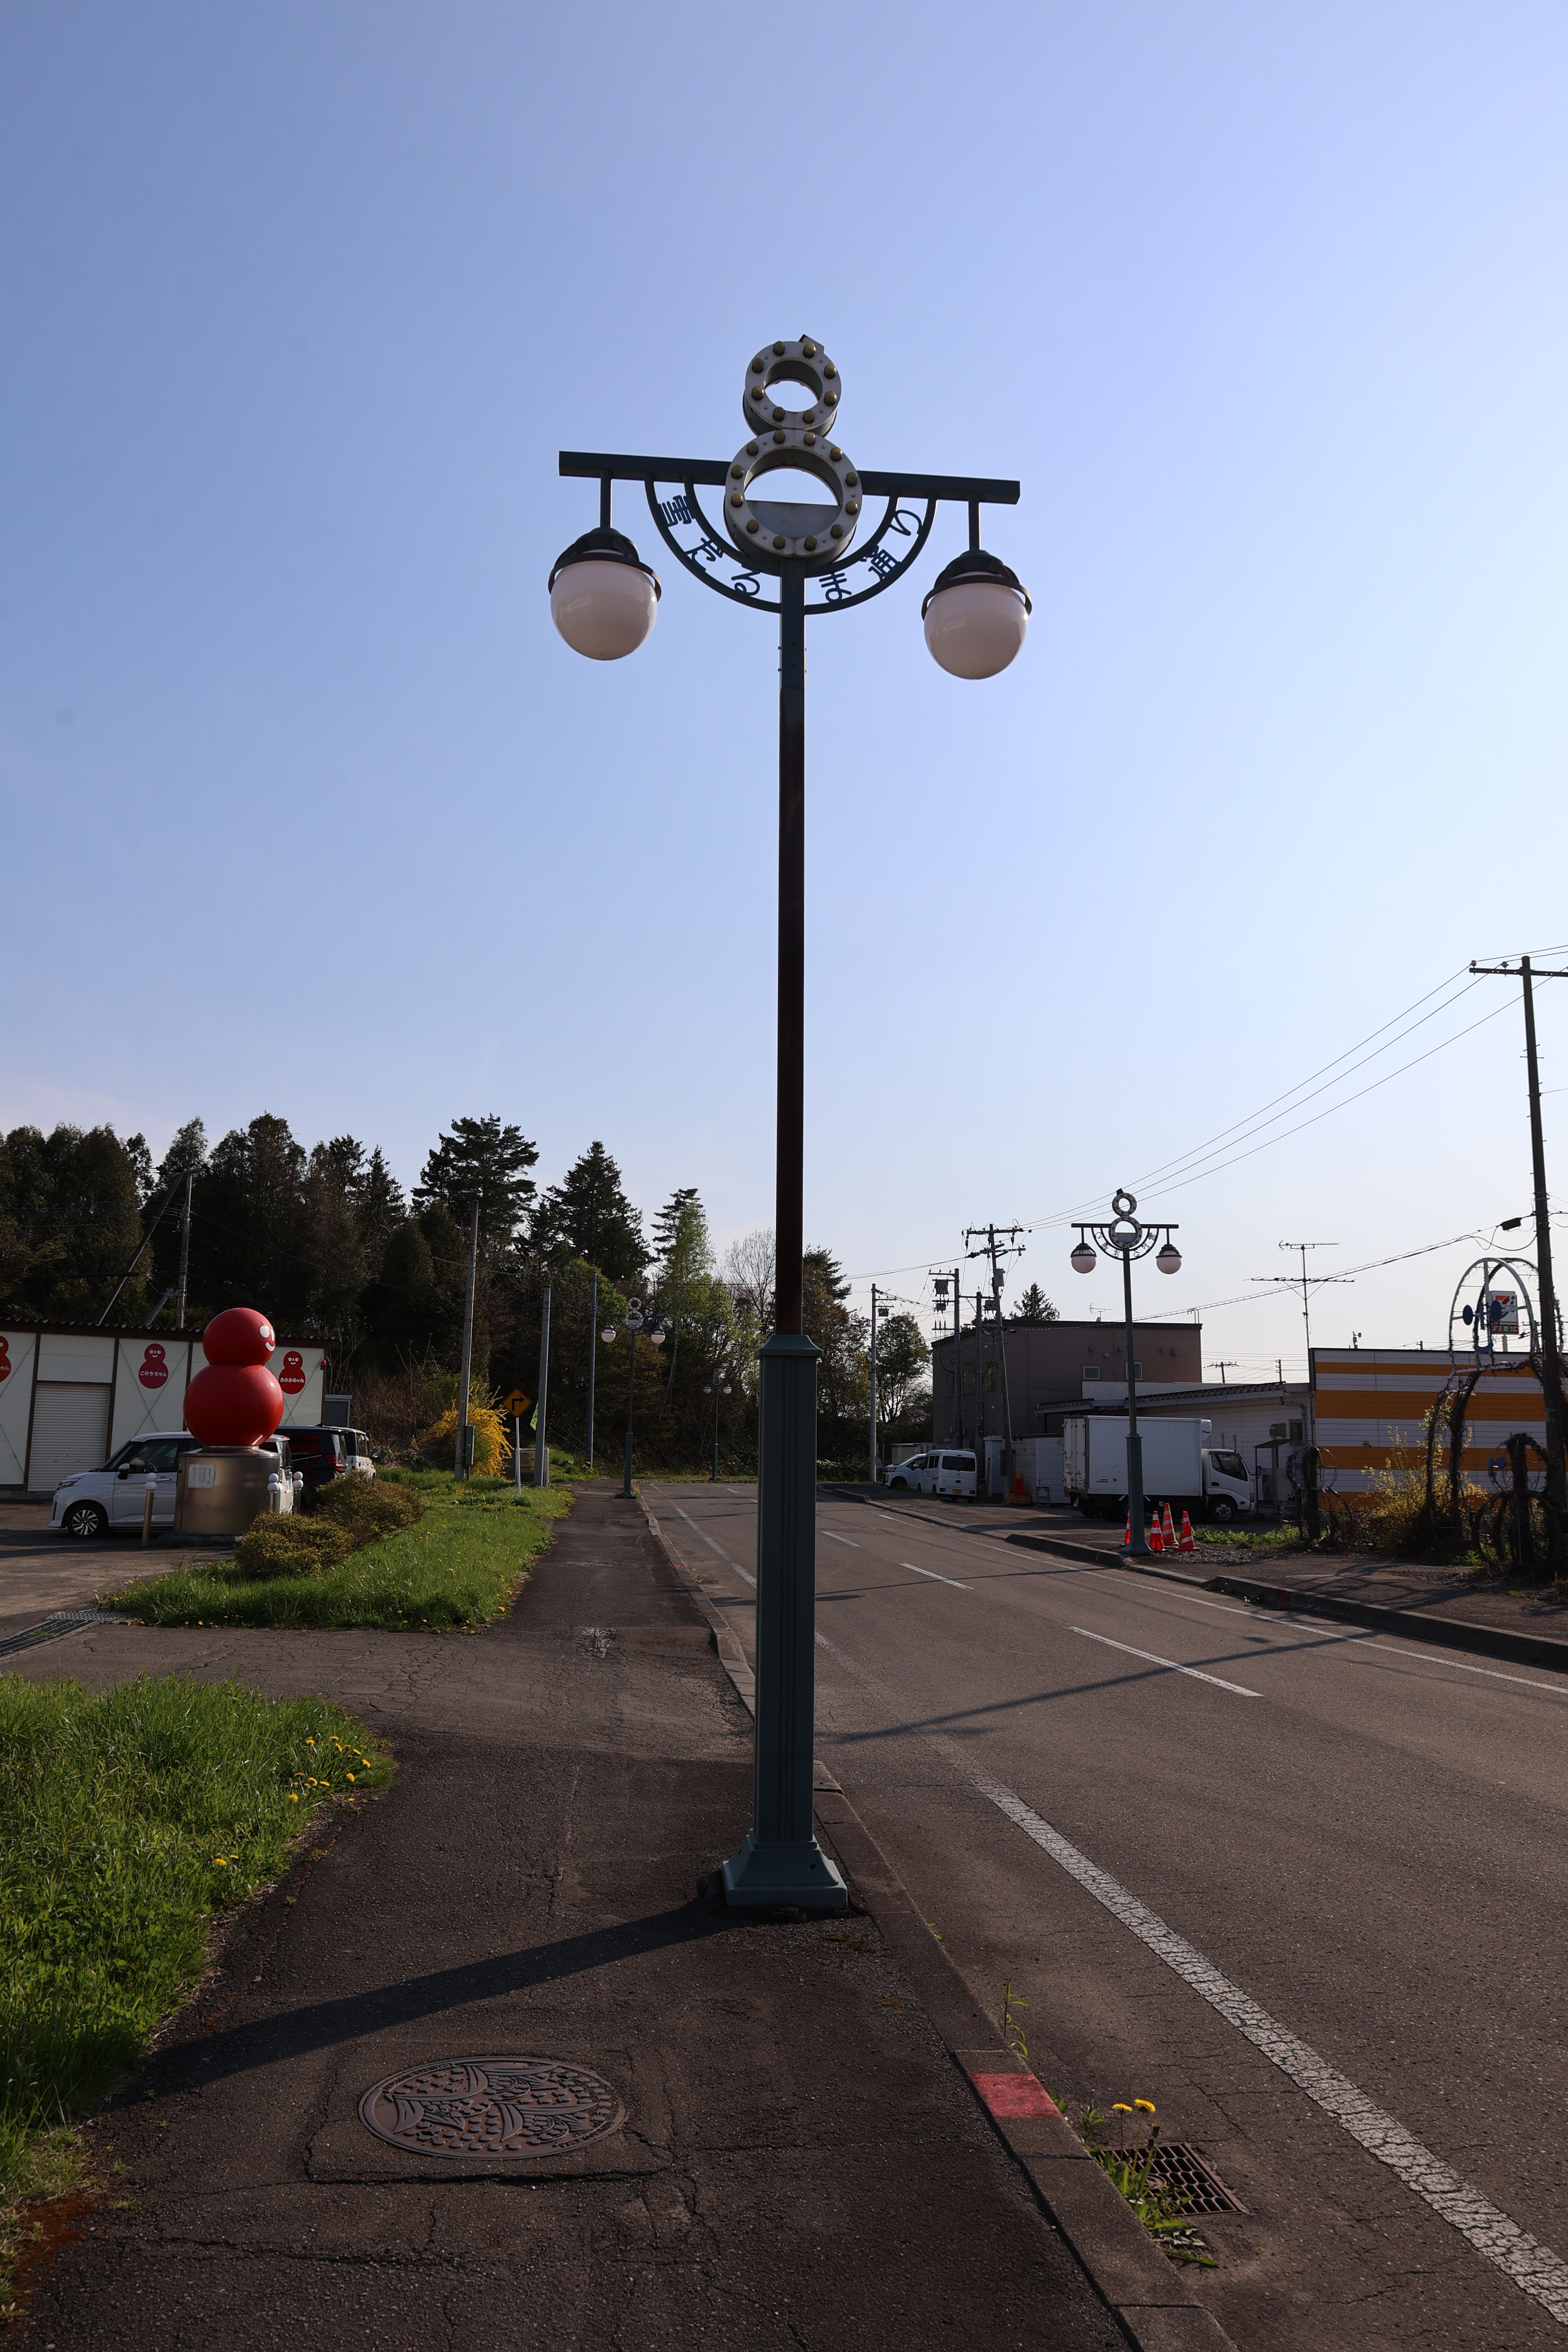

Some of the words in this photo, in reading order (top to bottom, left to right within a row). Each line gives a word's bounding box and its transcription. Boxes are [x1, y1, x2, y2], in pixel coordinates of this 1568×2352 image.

[658, 495, 922, 603] 雪だるま通り
